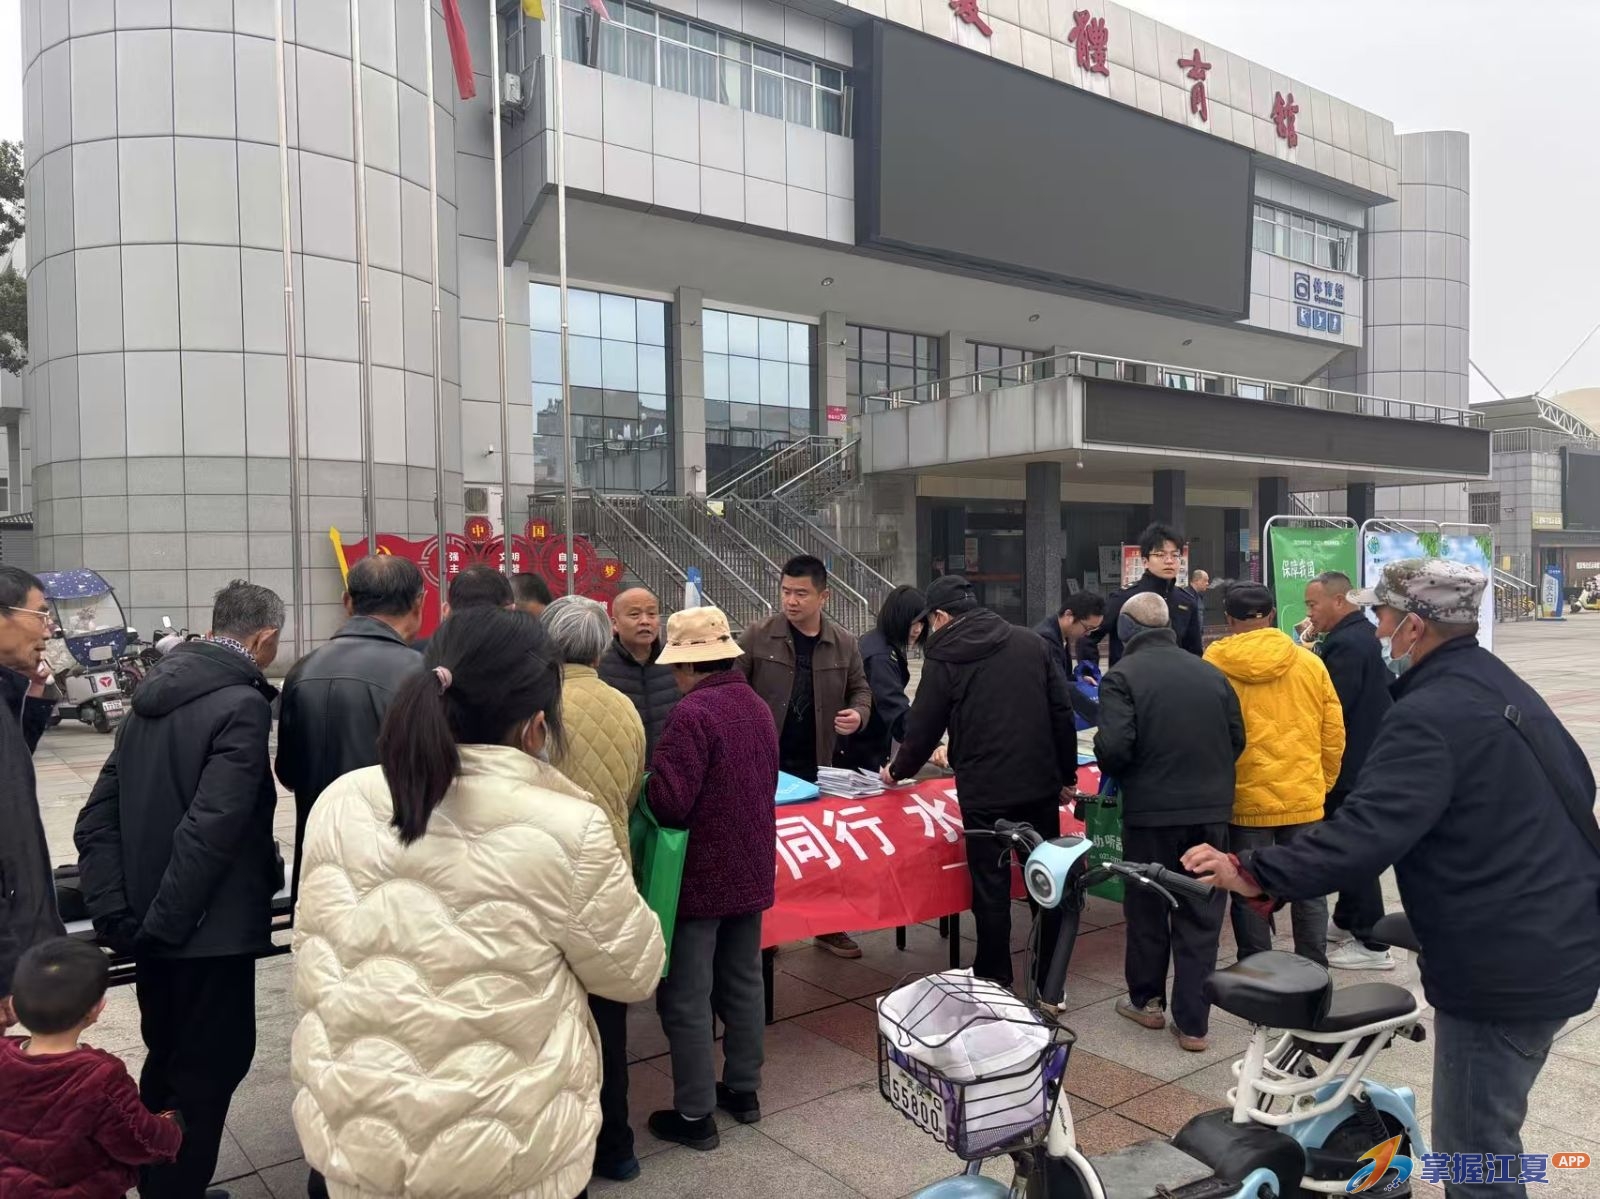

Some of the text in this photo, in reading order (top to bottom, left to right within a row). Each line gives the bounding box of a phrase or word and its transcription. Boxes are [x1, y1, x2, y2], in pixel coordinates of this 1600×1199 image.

[472, 524, 484, 537] 中
[532, 525, 545, 538] 国
[893, 1078, 939, 1132] 55800
